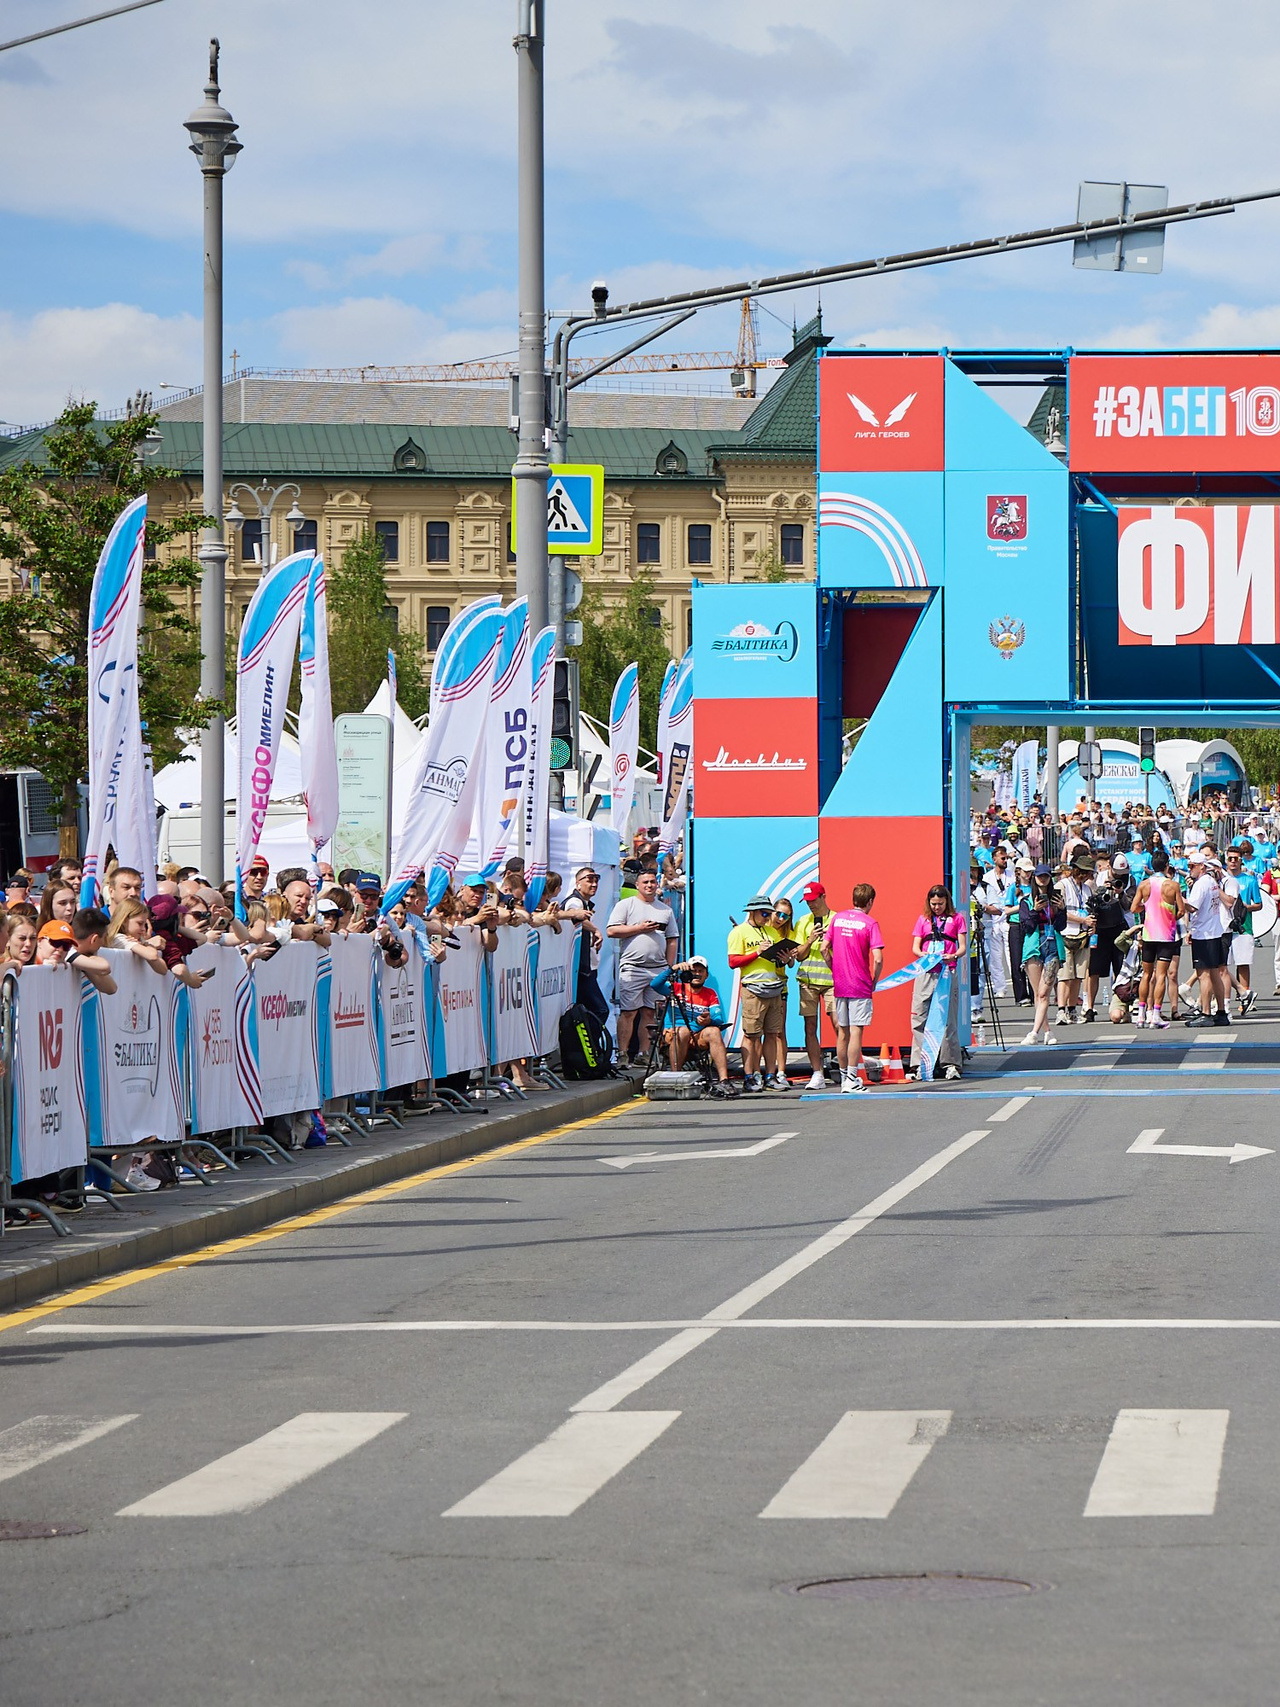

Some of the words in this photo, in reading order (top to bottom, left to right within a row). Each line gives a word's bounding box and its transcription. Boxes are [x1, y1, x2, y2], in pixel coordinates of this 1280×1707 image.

[1092, 386, 1226, 437] #ЗАБЕГ
[724, 639, 789, 651] БАЛТИКА
[504, 707, 528, 791] ПСБ
[1102, 765, 1137, 777] ЕЖСКАЯ
[38, 1008, 63, 1072] NRG
[120, 1042, 157, 1067] БАЛТИКА
